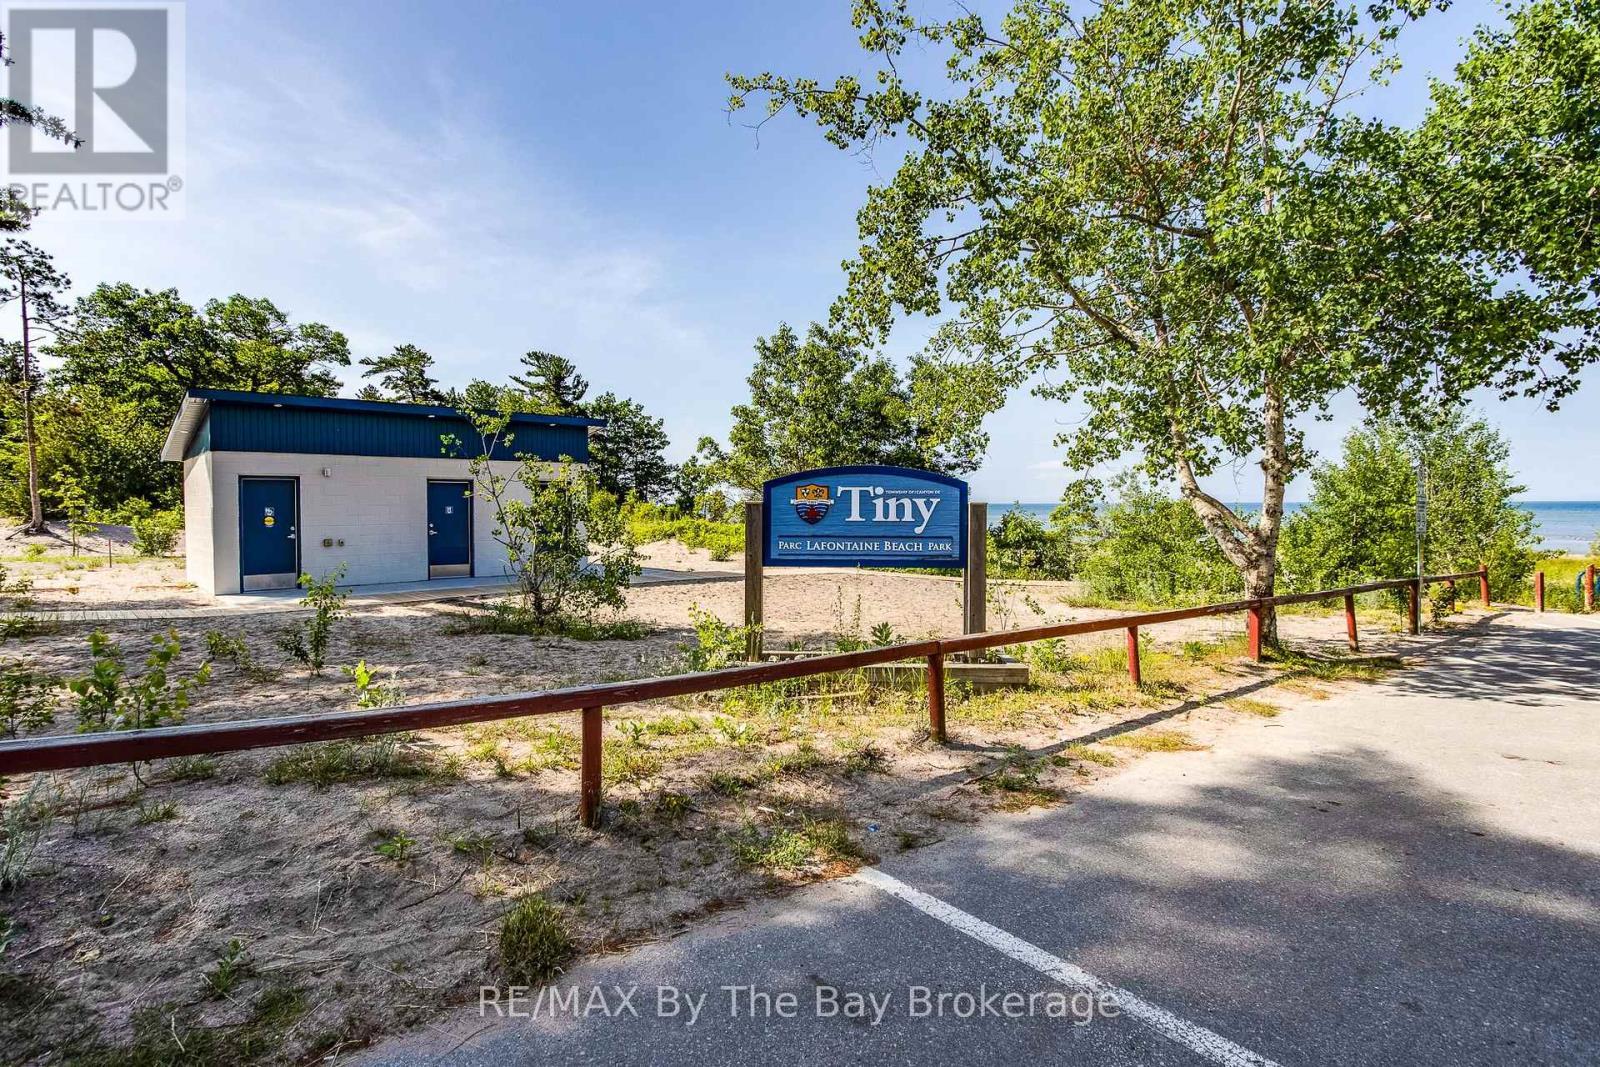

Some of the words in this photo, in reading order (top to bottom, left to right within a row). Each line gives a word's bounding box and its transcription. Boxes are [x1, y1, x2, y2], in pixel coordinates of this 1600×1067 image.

[837, 485, 941, 535] Tiny
[778, 540, 802, 550] PARC
[806, 540, 880, 551] LAFONTAINE
[884, 540, 922, 551] BEACH
[928, 542, 952, 551] PARK
